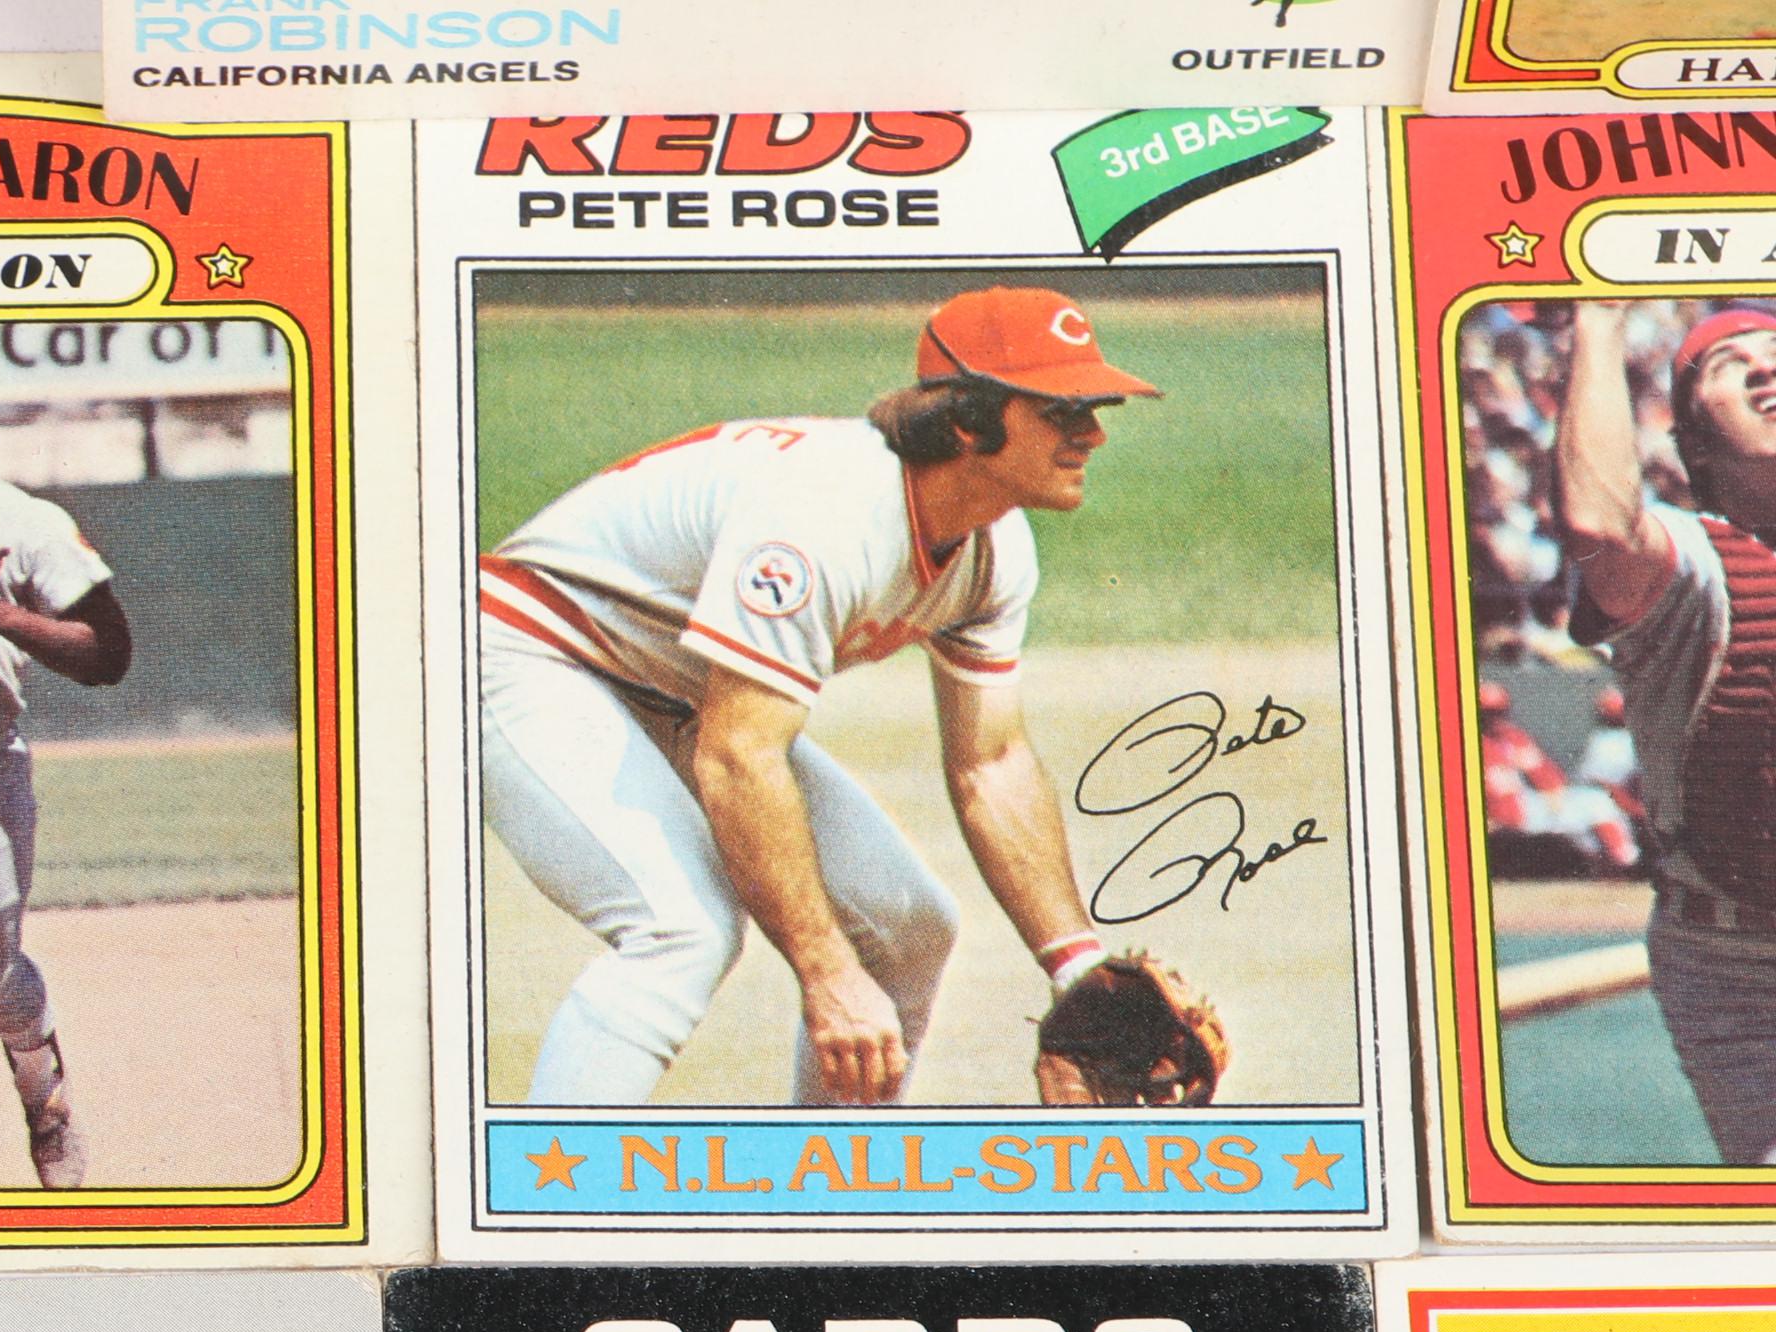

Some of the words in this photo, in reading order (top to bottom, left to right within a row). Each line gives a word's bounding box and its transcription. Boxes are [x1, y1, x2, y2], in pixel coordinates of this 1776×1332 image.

[134, 9, 621, 53] ROBINSON
[132, 64, 393, 87] CALIFORNIA
[406, 60, 580, 84] ANGELS
[1171, 46, 1386, 71] OUTFIELD
[1677, 57, 1776, 82] HA
[475, 111, 972, 176] REDS
[1099, 132, 1171, 179] 3rd
[1171, 106, 1290, 156] BASE
[519, 190, 709, 228] PETE
[732, 189, 940, 228] ROSE
[1654, 228, 1731, 264] IN
[1050, 308, 1092, 347] C
[1075, 691, 1307, 816] Pete
[1090, 791, 1329, 925] Rose
[619, 1134, 773, 1194] N.L.
[788, 1133, 1263, 1196] ALL-STARS
